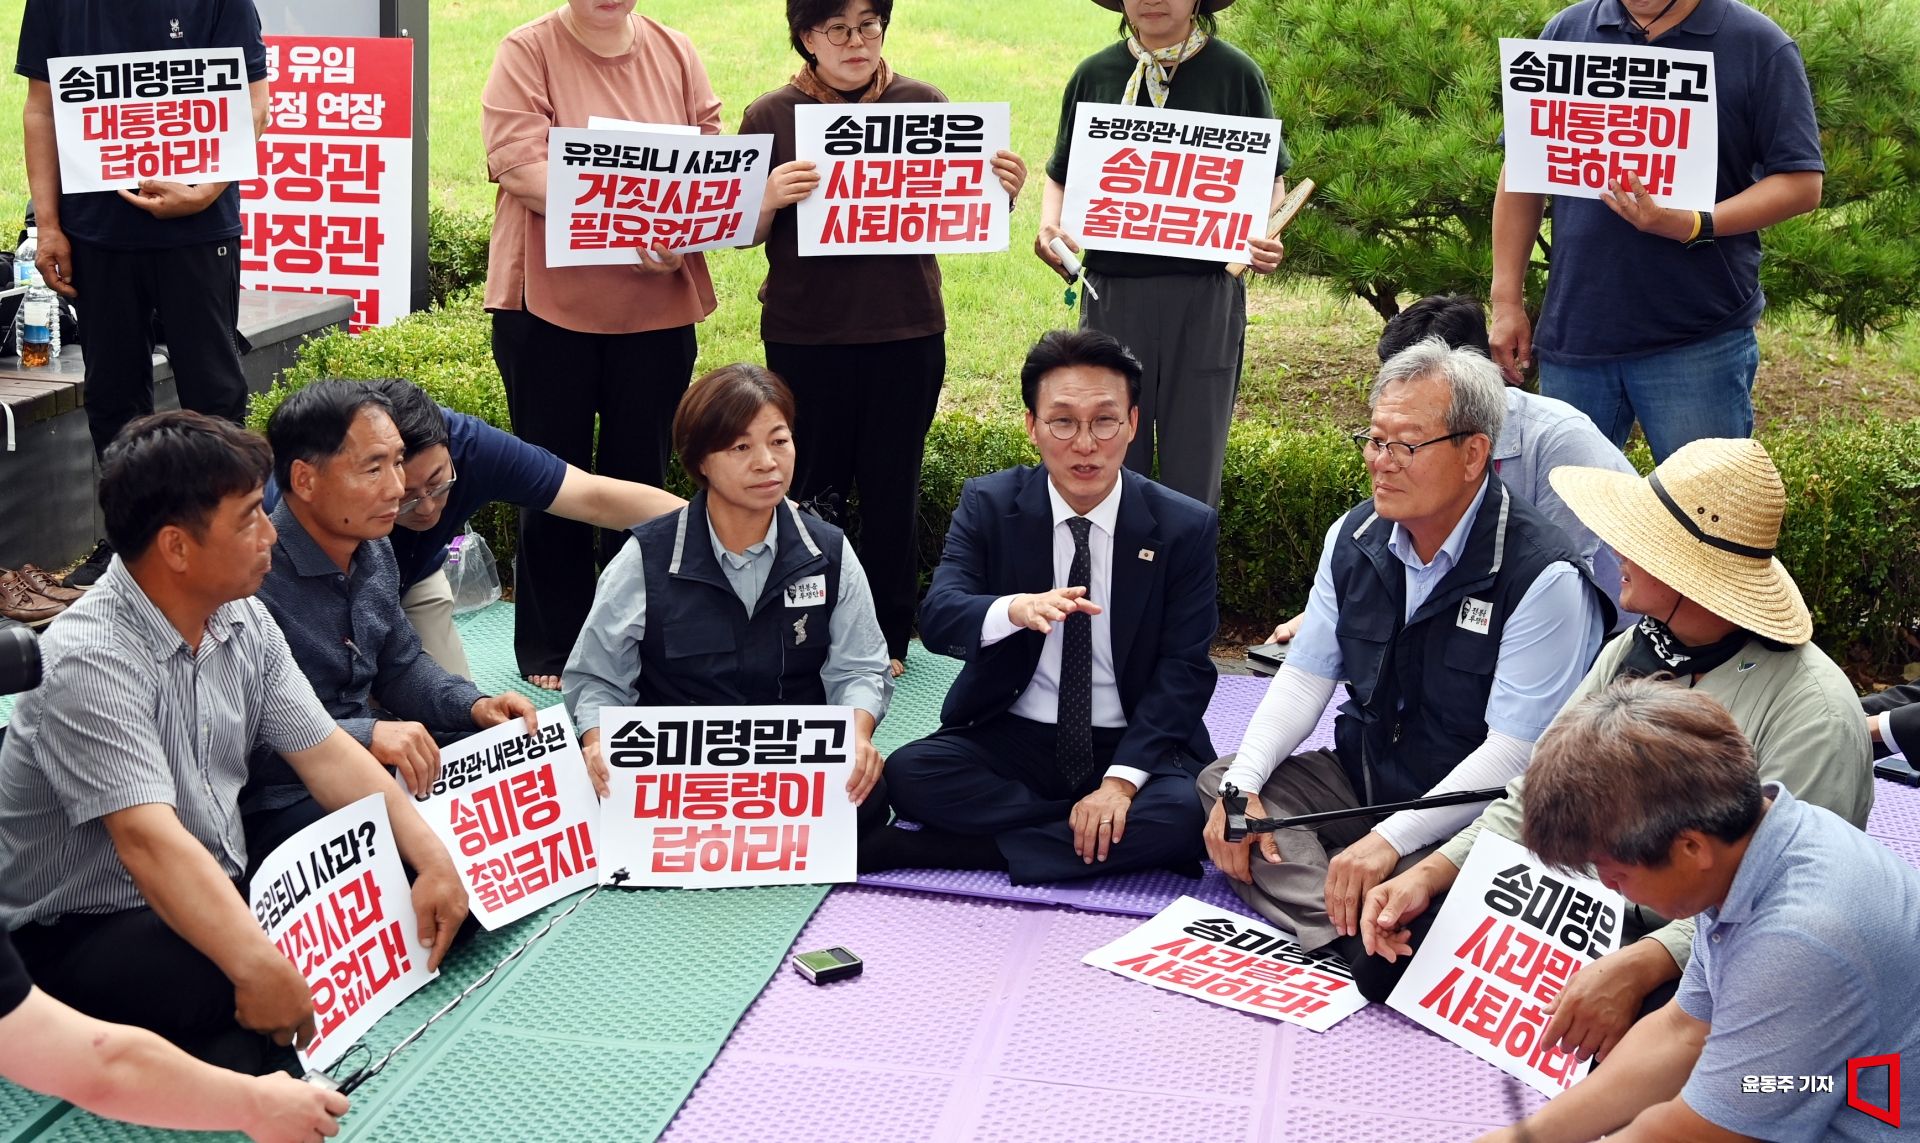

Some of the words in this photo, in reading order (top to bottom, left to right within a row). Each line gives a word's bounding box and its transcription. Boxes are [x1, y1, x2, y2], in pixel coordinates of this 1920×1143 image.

[59, 58, 242, 103] 송미령말고
[288, 46, 355, 84] 유임
[1509, 50, 1709, 103] 송미령말고
[82, 97, 229, 141] 대통령이
[268, 91, 308, 129] 정
[316, 92, 386, 131] 연장
[825, 114, 984, 156] 송미령은
[1530, 98, 1690, 149] 대통령이
[100, 138, 220, 181] 답하라!
[562, 142, 680, 174] 유임되니
[683, 149, 760, 174] 사과?
[825, 160, 984, 200] 사과말고
[1100, 147, 1244, 204] 송미령
[1546, 144, 1677, 196] 답하라!
[575, 173, 742, 215] 거짓사과
[569, 212, 743, 252] 필요없다!
[819, 202, 991, 244] 사퇴하라!
[1083, 196, 1253, 251] 출입금지!
[610, 719, 847, 768] 송미령말고
[450, 763, 561, 857] 송미령
[634, 772, 825, 820] 대통령이
[310, 821, 377, 890] 사과?
[466, 821, 598, 913] 출입금지!
[651, 824, 809, 873] 답하라!
[1484, 863, 1617, 961] 송미령은
[304, 919, 412, 1058] 요없다!
[1113, 953, 1330, 1019] 사퇴하라!
[1151, 937, 1349, 997] 사과말고
